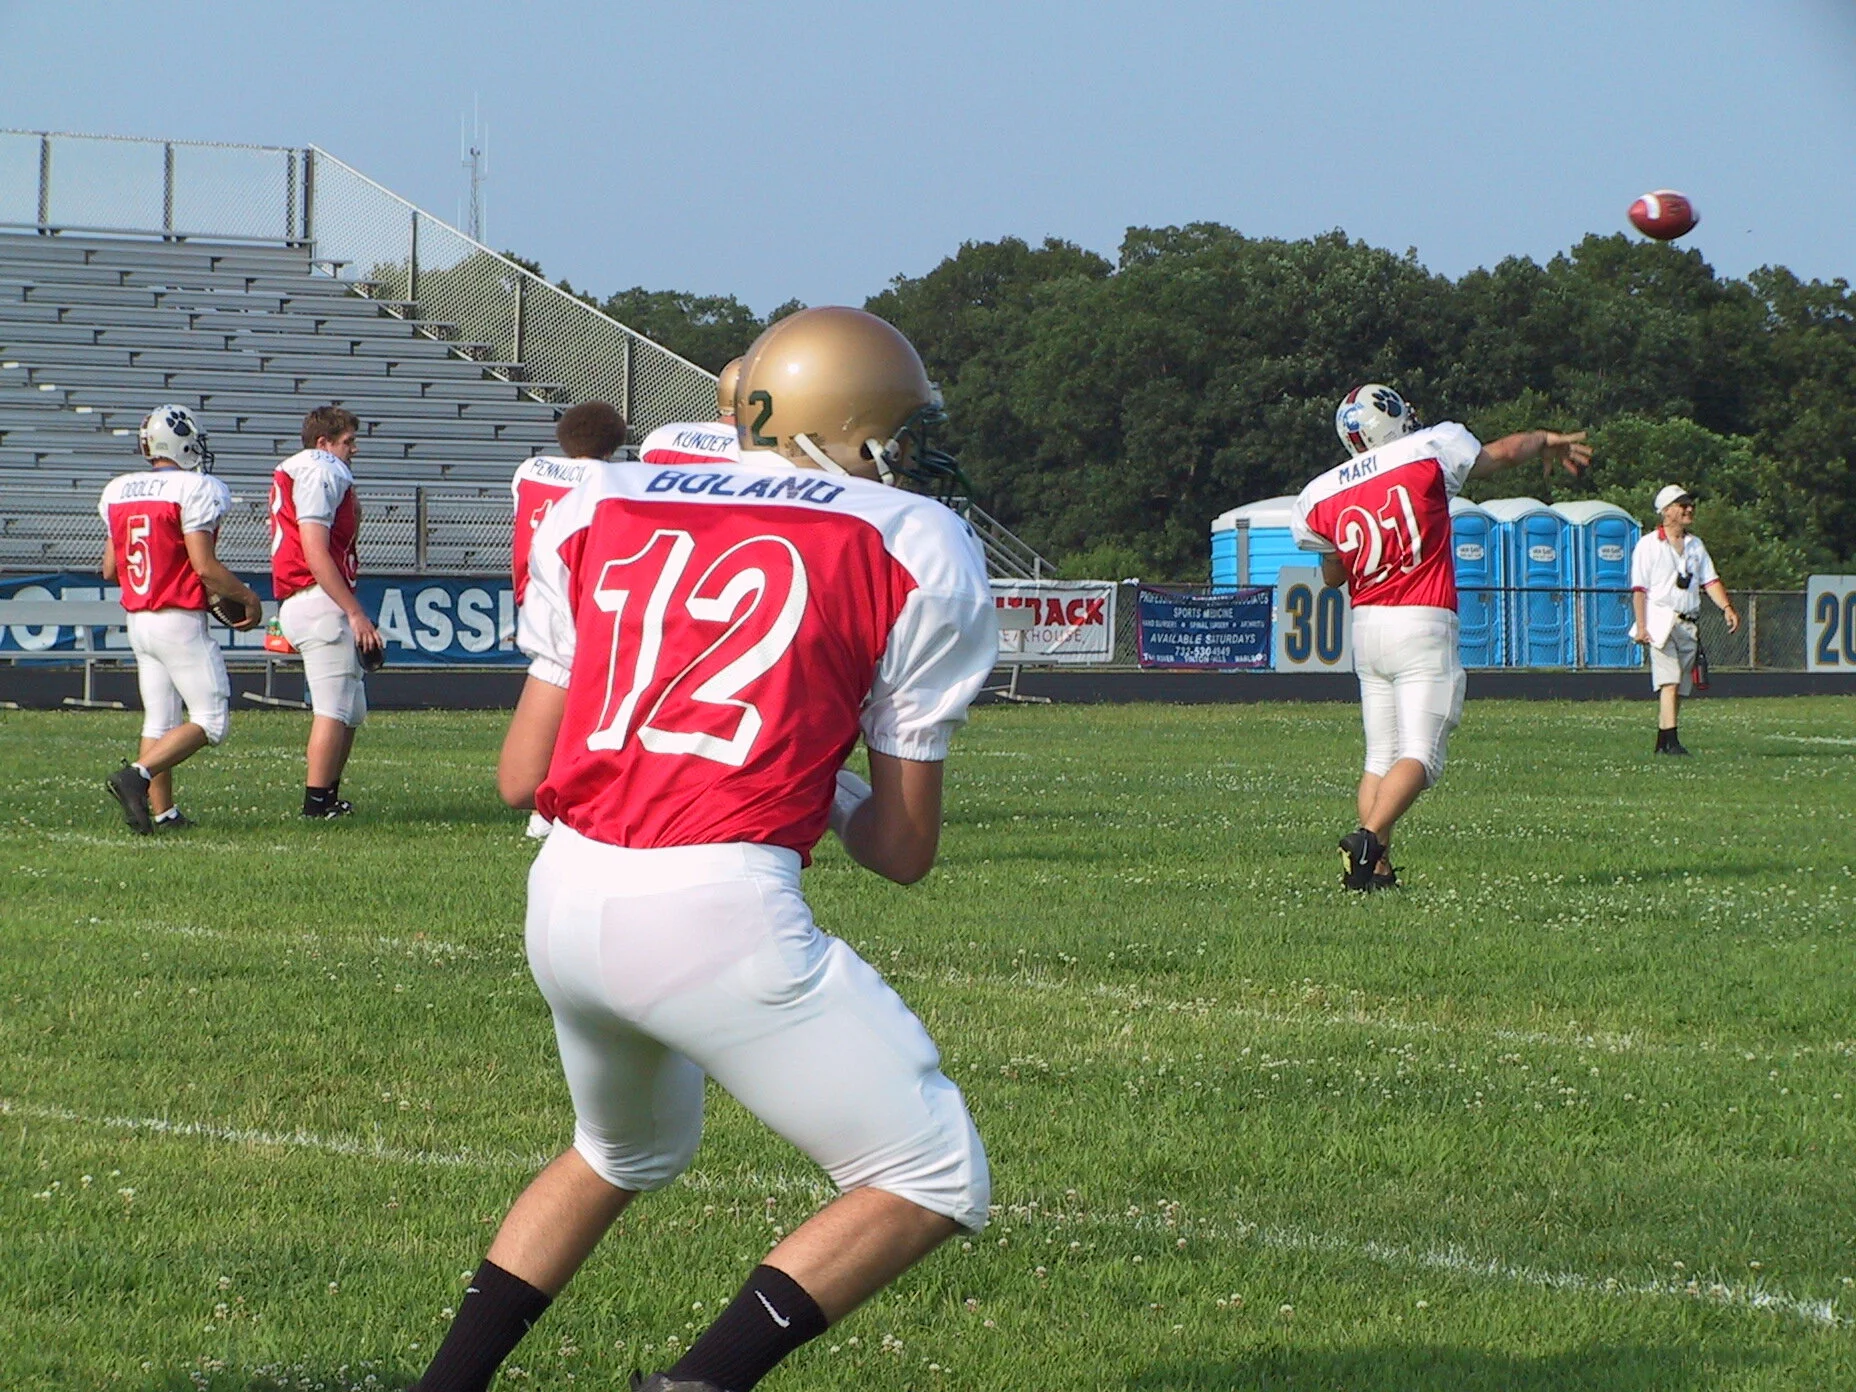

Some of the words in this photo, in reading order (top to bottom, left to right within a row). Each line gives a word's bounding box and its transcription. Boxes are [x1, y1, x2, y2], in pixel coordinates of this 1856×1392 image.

[750, 391, 779, 447] 2
[672, 431, 735, 453] KUNDER
[646, 470, 846, 505] BOLAND
[1338, 454, 1378, 486] MARI
[120, 478, 167, 499] DOOLEY
[126, 513, 154, 596] 5
[1335, 484, 1423, 592] 21
[1173, 607, 1202, 619] SPORTS
[1284, 582, 1345, 665] 30
[586, 527, 809, 767] 12
[1150, 633, 1202, 645] AVAILABLE
[1205, 633, 1256, 645] SATURDAYS
